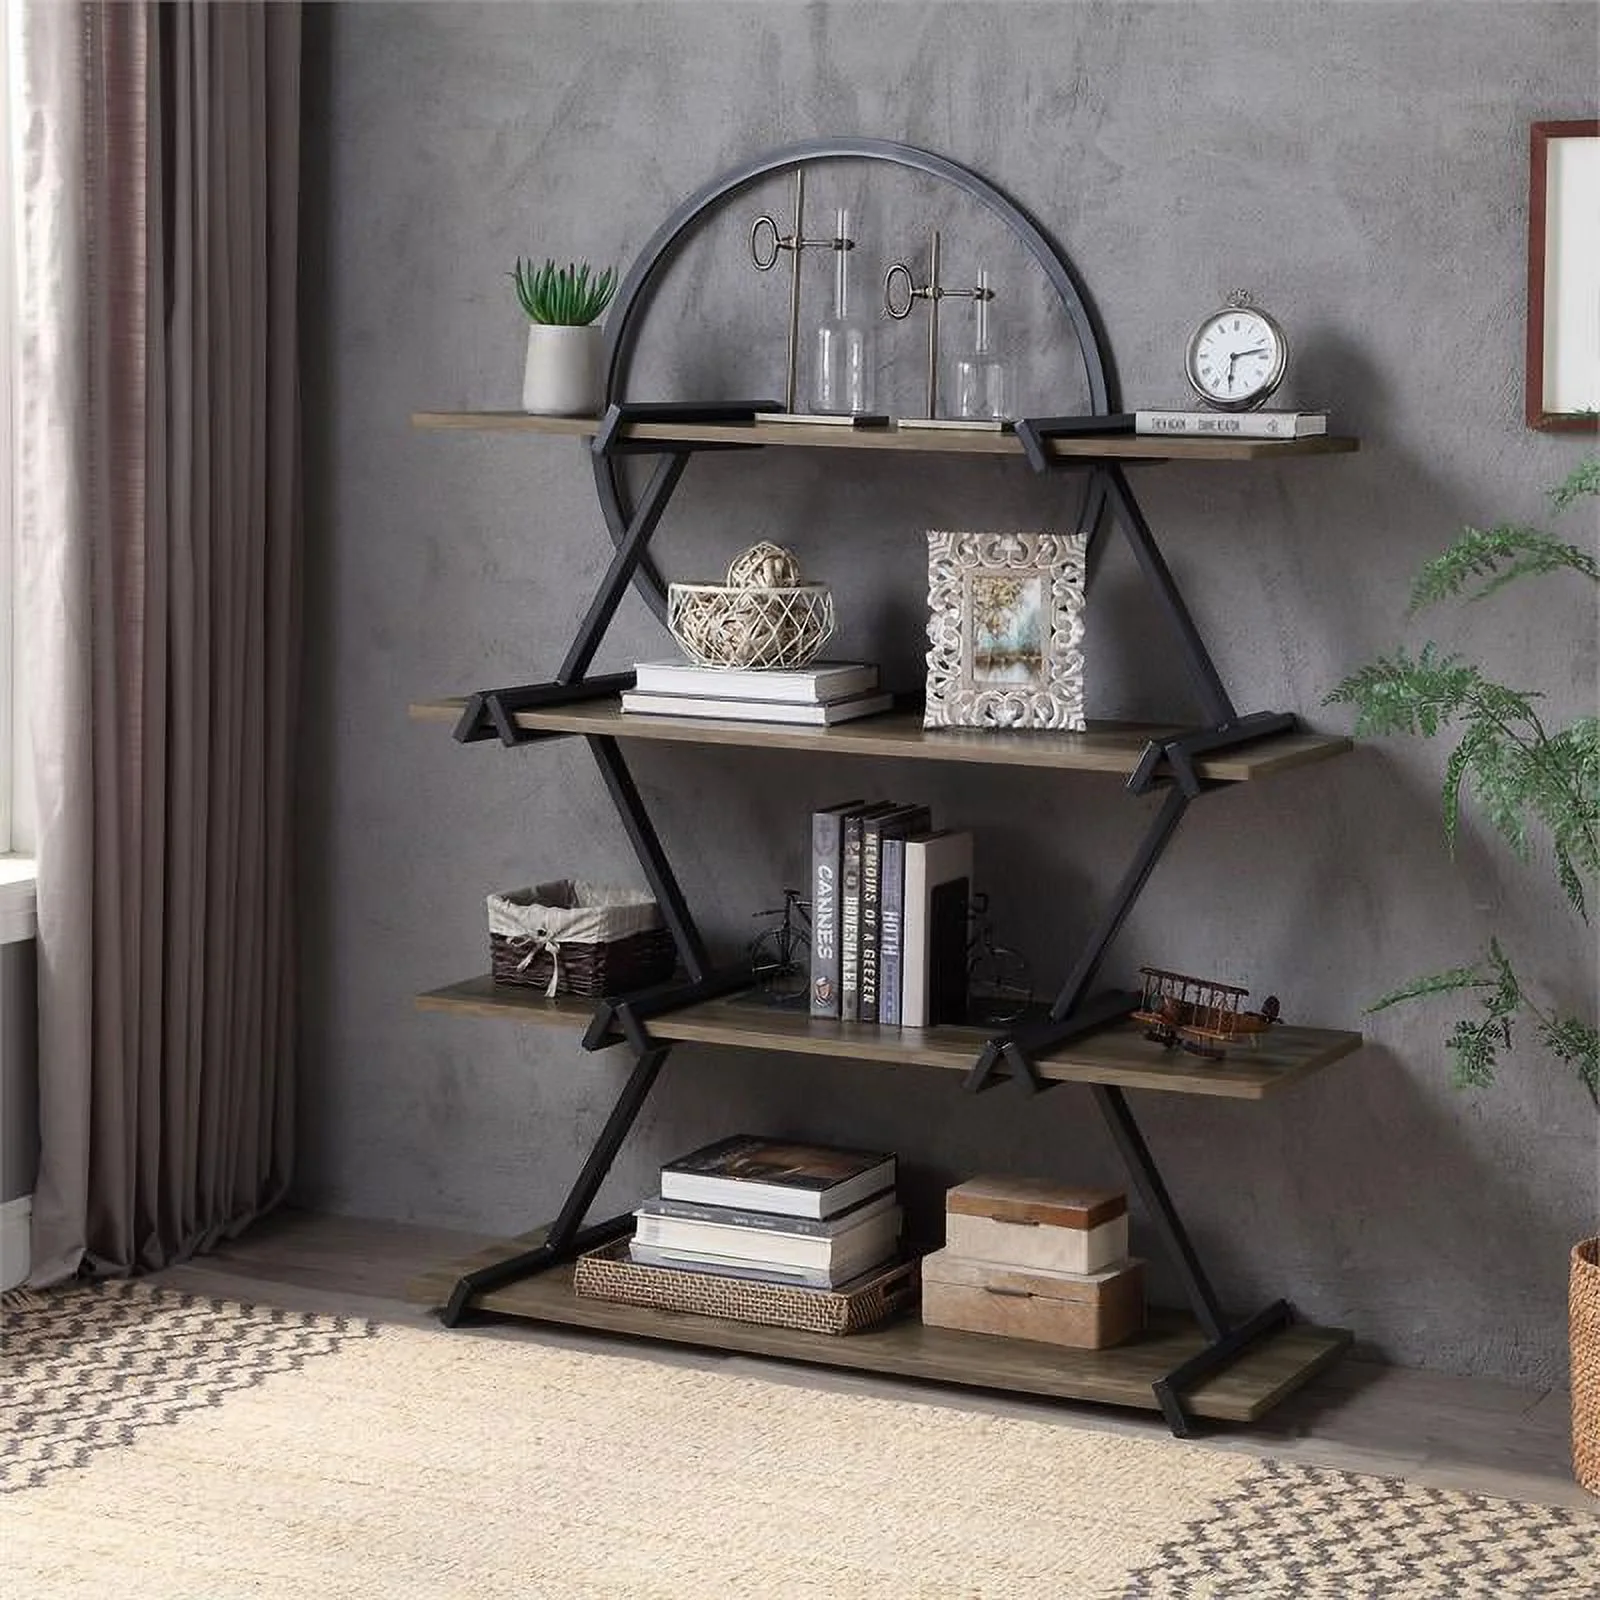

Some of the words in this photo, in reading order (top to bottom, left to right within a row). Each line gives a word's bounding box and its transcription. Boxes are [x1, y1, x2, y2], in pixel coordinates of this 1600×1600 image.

[864, 832, 878, 902] MEMOIRS
[816, 865, 833, 960] CANNES
[863, 934, 874, 942] A
[864, 908, 876, 925] OF
[863, 949, 876, 1004] GEEZER
